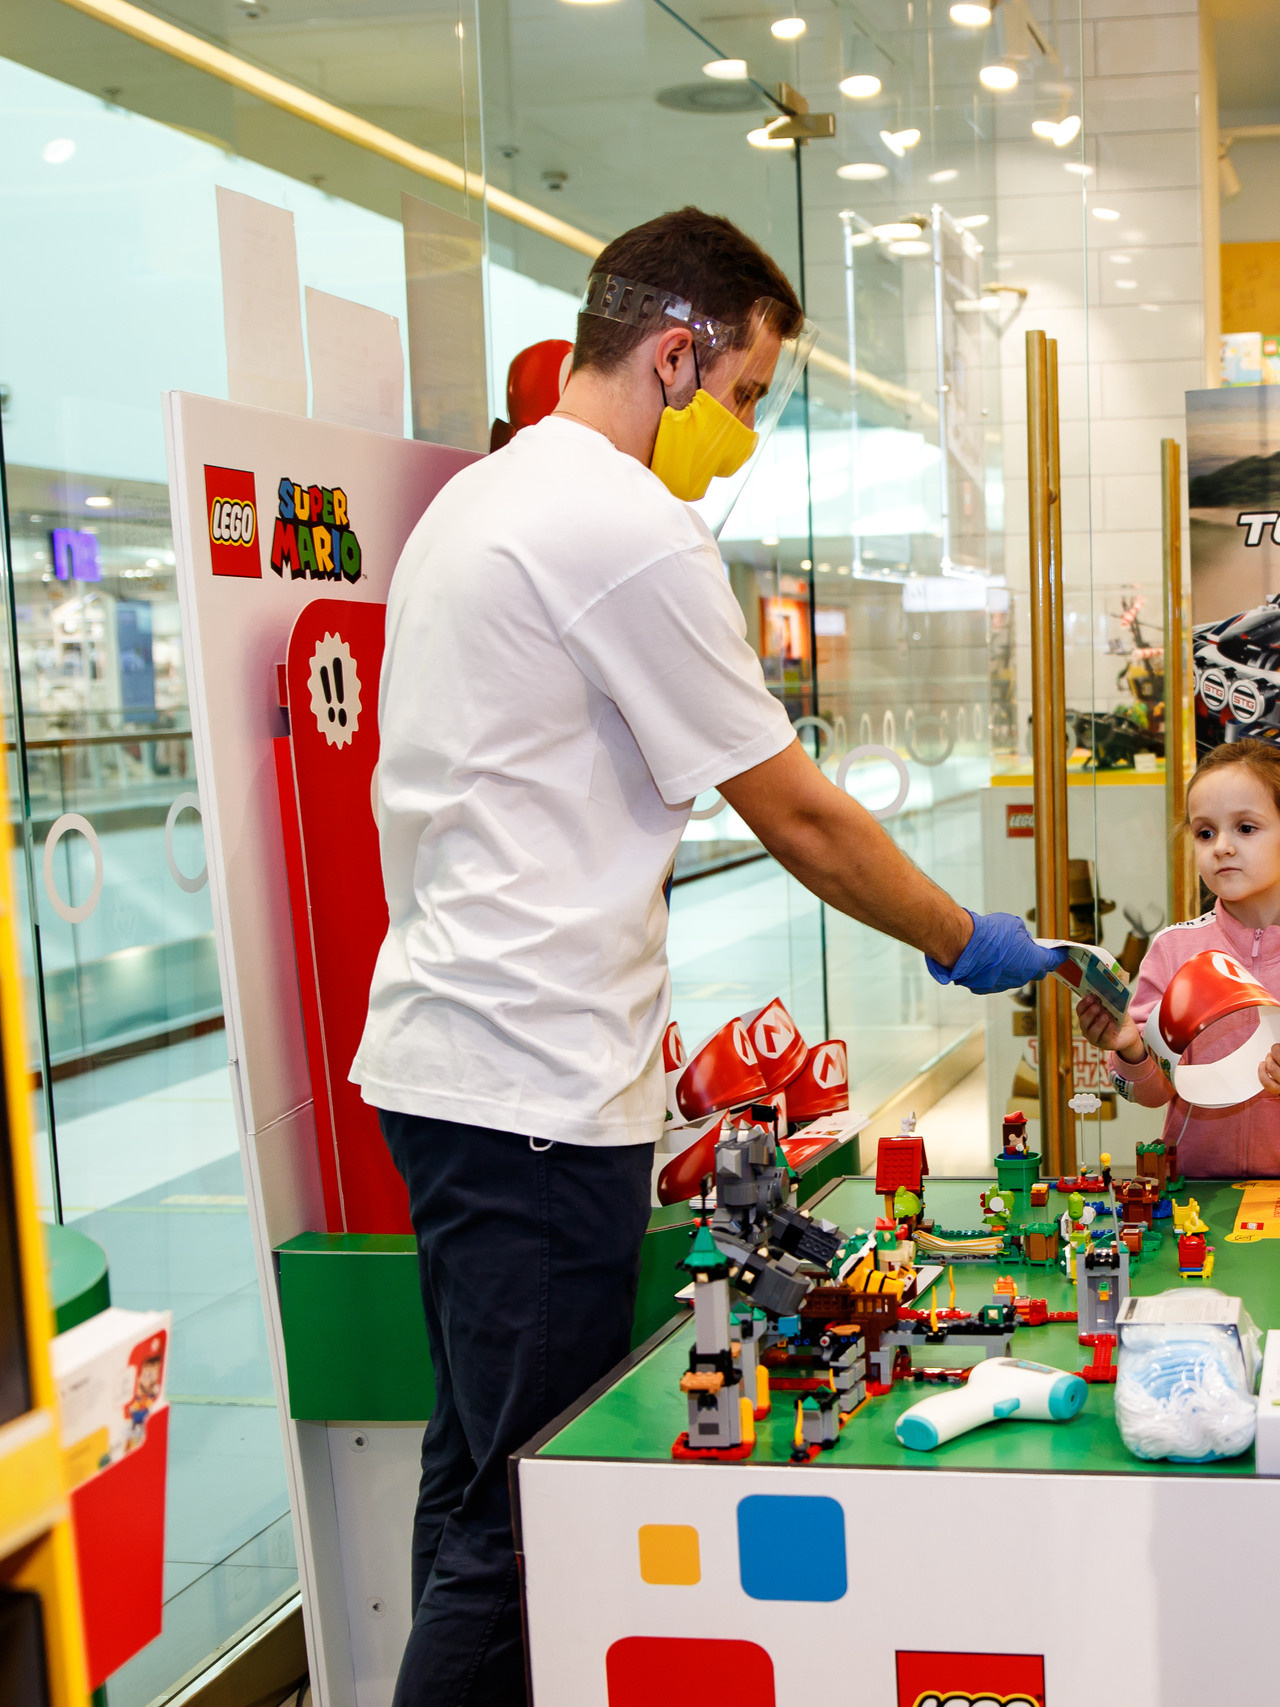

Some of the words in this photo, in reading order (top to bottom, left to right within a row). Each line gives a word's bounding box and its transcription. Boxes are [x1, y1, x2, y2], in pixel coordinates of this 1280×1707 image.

[212, 501, 255, 543] LEGO
[278, 477, 349, 526] SUPER
[271, 517, 362, 584] MARIO
